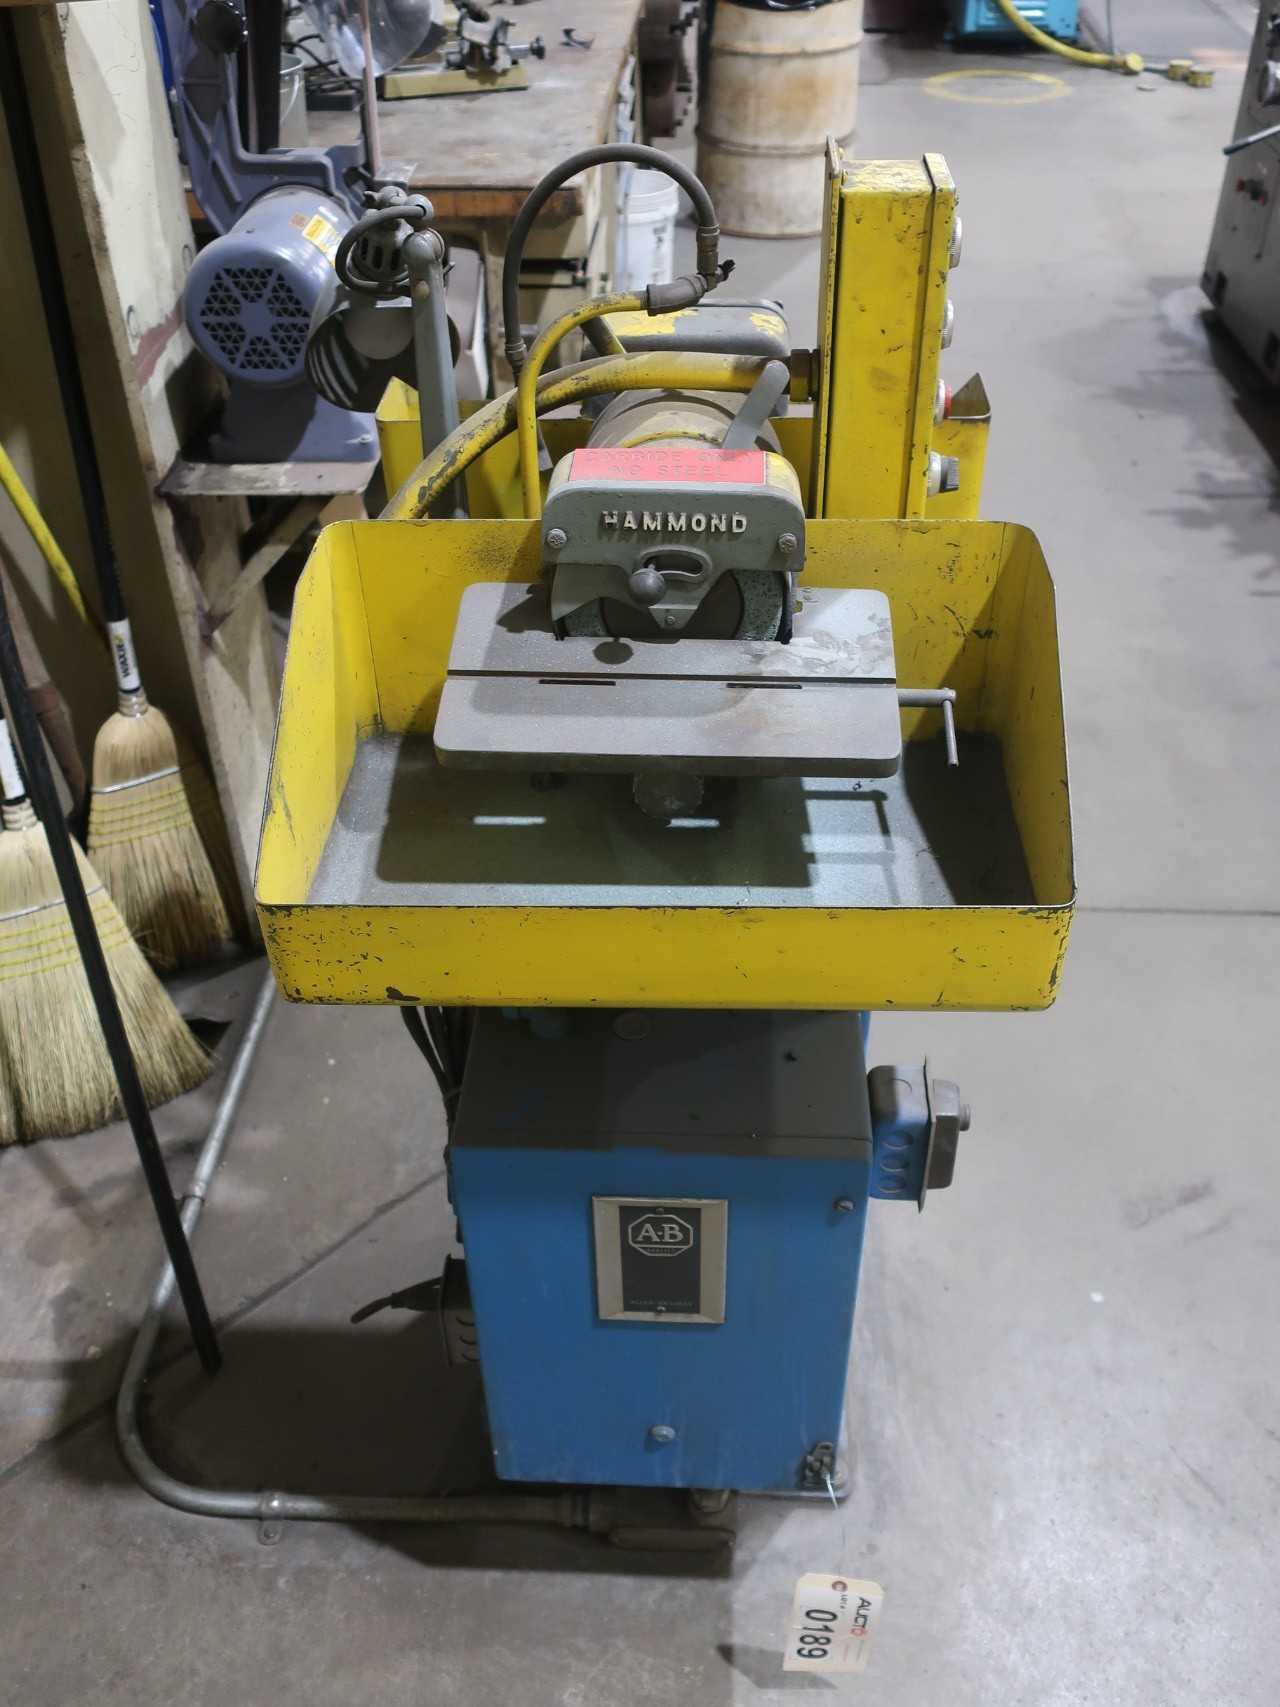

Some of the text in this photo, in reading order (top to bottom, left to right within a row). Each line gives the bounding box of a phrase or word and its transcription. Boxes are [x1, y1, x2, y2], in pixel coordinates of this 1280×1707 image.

[658, 465, 730, 477] STEEL
[602, 510, 748, 533] HAMMOND
[636, 1223, 684, 1242] A-B
[797, 1609, 838, 1659] 0189
